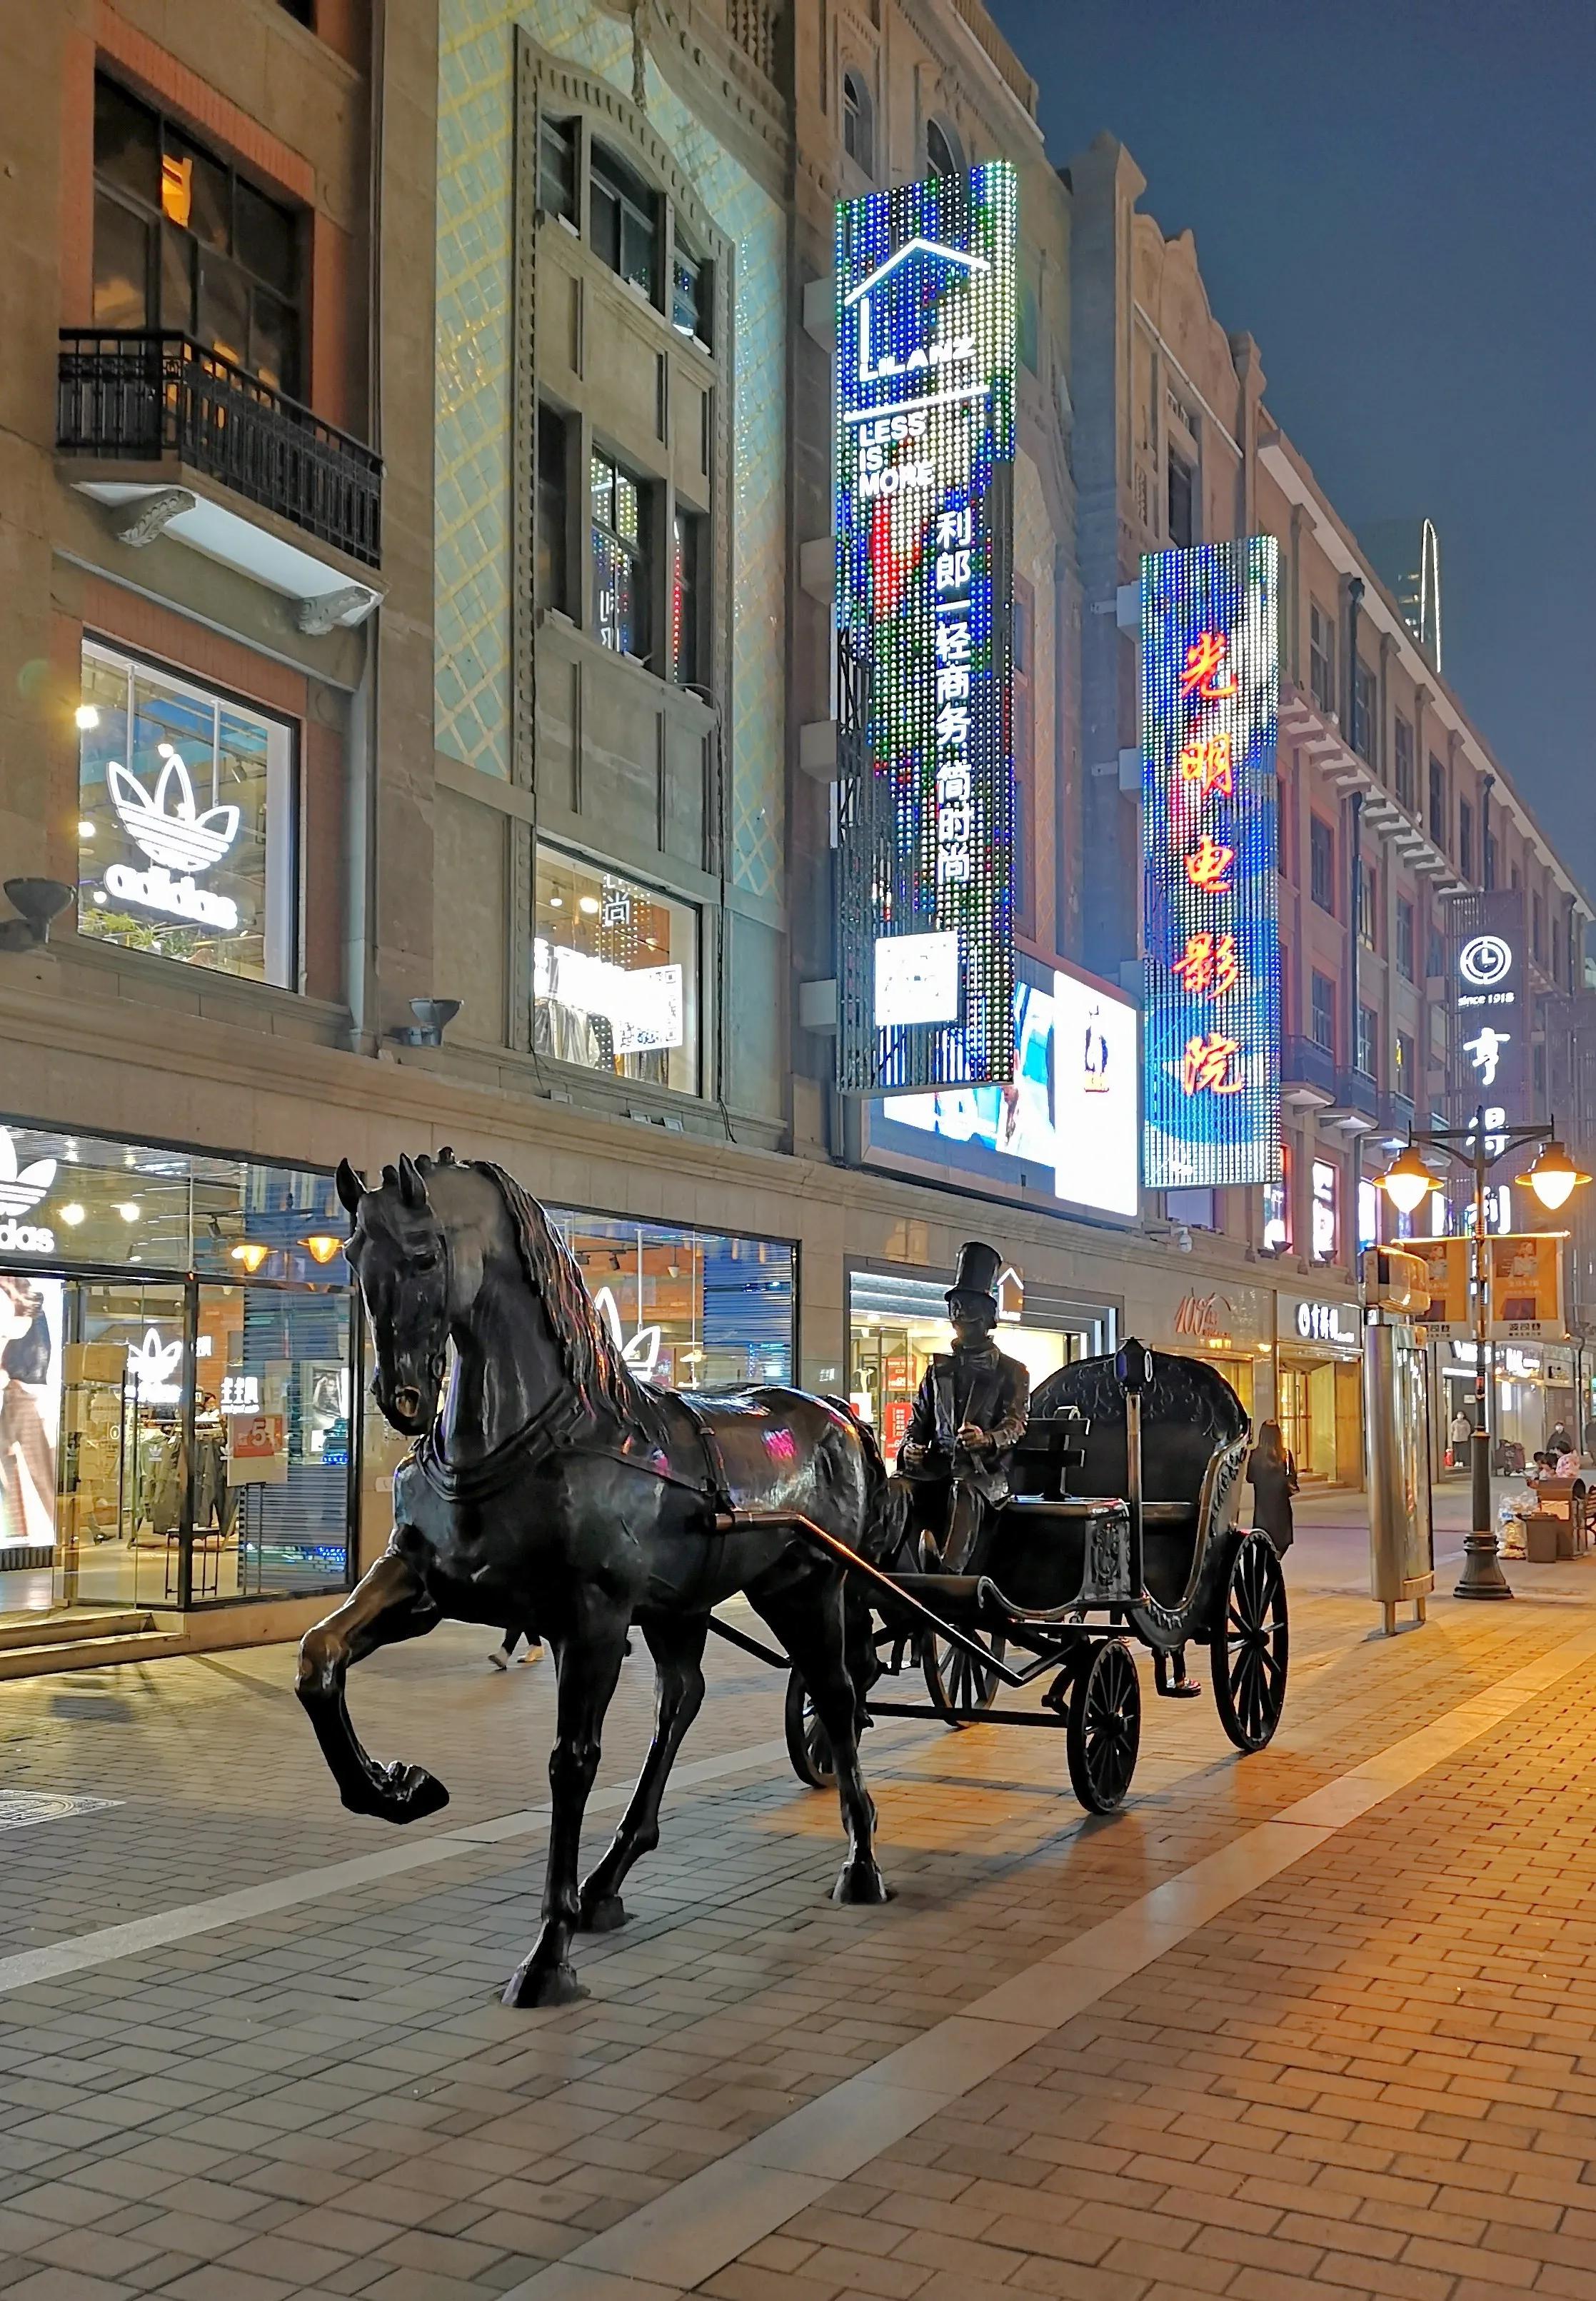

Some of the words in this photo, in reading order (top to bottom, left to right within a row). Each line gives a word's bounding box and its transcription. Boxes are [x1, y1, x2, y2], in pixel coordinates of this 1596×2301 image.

[858, 334, 977, 382] LILANZ
[859, 413, 927, 448] LESS
[859, 446, 883, 472] IS
[859, 461, 935, 498] MORE
[1173, 631, 1243, 1096] 光明电影院
[104, 863, 238, 930] adidas
[1457, 993, 1487, 1006] since
